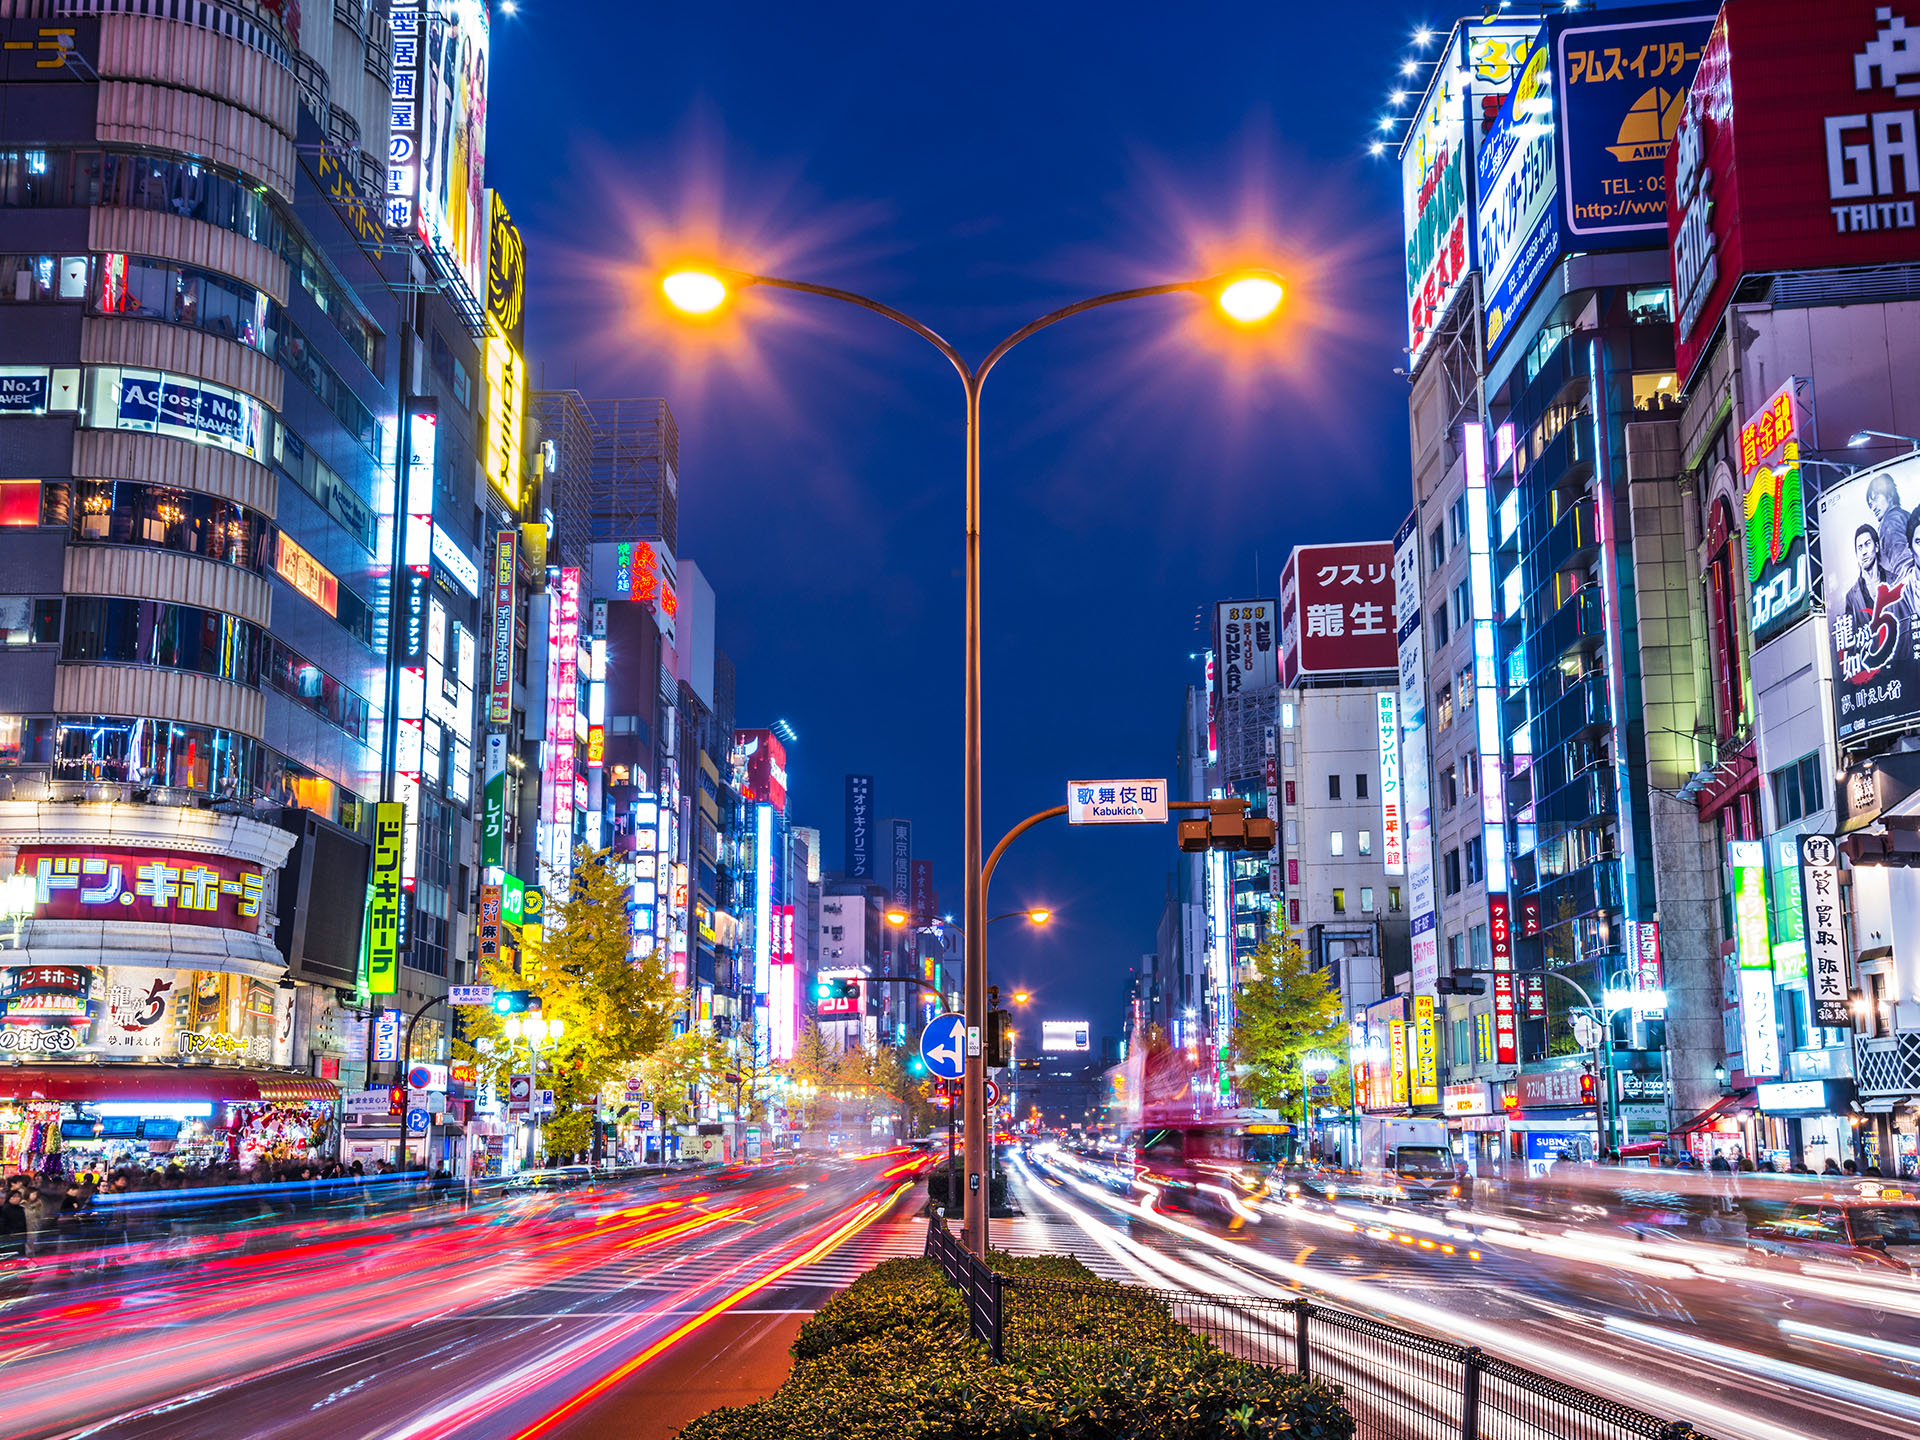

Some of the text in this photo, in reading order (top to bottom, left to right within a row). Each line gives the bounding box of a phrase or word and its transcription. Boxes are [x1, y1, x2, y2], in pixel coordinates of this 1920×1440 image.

[1567, 41, 1705, 84] アムス・インター
[387, 0, 417, 228] 型居酒屋の聖地
[1408, 138, 1464, 298] SUNPARK
[1830, 201, 1916, 233] TAITO
[3, 379, 42, 392] No.1
[1316, 563, 1396, 587] クスリ
[1307, 601, 1398, 638] 龍生
[1243, 622, 1253, 671] SHINJUKU
[1256, 621, 1271, 652] NEW
[1226, 623, 1242, 695] SUNPARK
[1077, 786, 1158, 805] 歌舞伎町
[1380, 696, 1401, 866] 新宿サンパーク 三平本館
[486, 798, 500, 838] レイク
[1092, 806, 1144, 817] Kabukicho
[853, 794, 866, 877] オザキクリニック
[895, 825, 907, 906] 東京信用金
[1808, 840, 1832, 863] 質
[482, 902, 490, 924] セット
[490, 899, 498, 921] フリー
[480, 925, 497, 954] 麻雀
[1812, 869, 1841, 997] 質・買取・販売
[452, 987, 490, 997] 歌舞伎町
[107, 1035, 162, 1047] 夢、叶えし者
[1526, 1073, 1583, 1101] クスリの龍生堂薬
[411, 1113, 423, 1128] P
[640, 1102, 649, 1113] P
